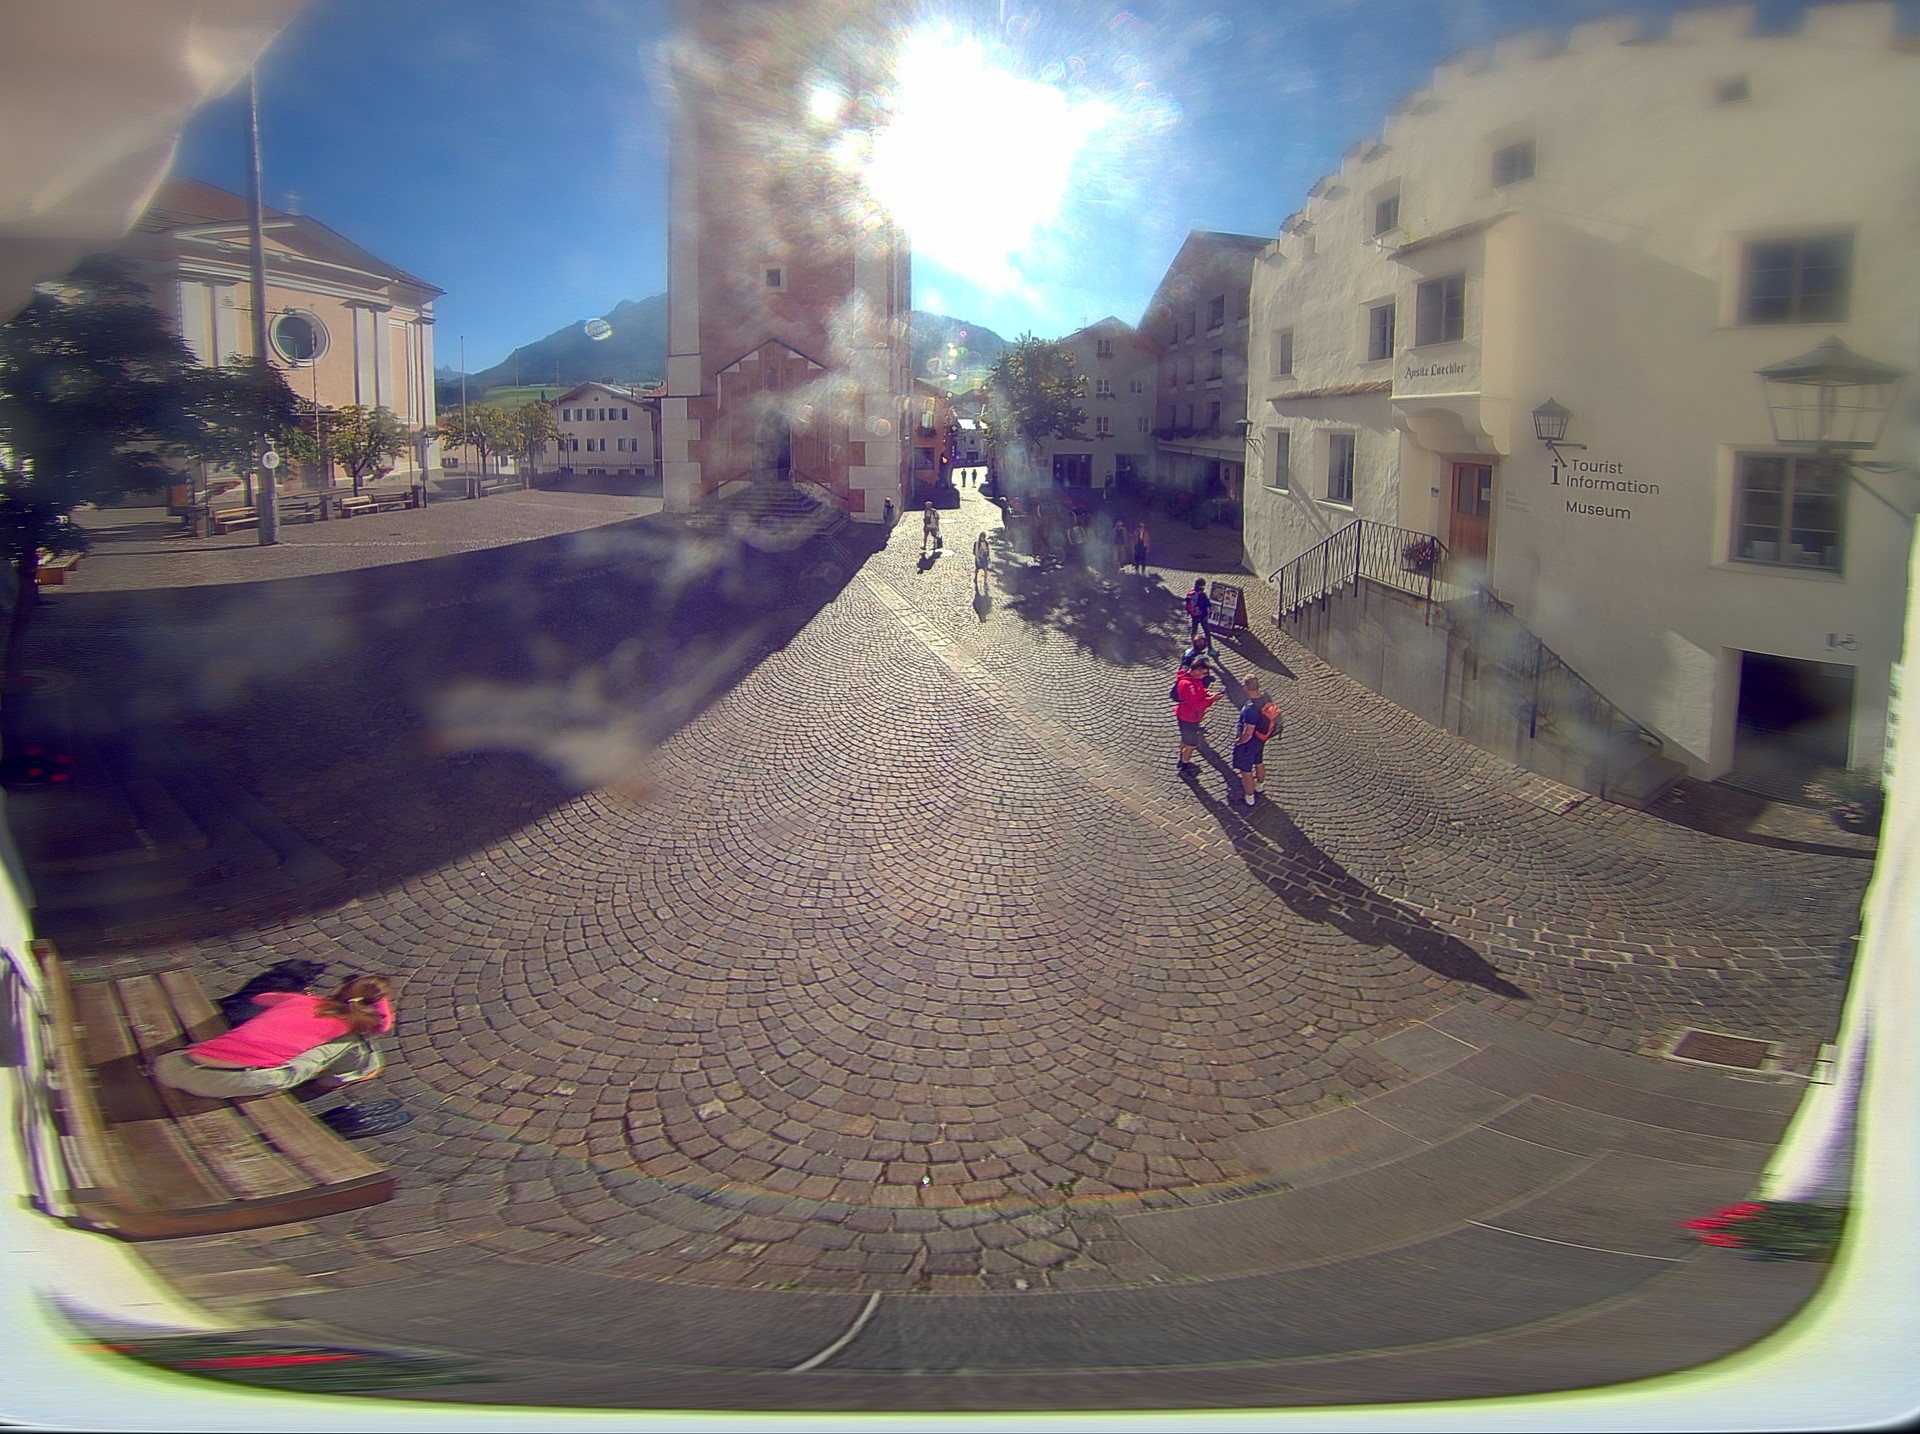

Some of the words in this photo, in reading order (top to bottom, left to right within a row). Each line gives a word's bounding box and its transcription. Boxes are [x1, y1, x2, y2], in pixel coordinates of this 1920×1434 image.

[1571, 458, 1624, 475] Tourist
[1566, 474, 1660, 495] Information
[1565, 501, 1631, 520] Museum
